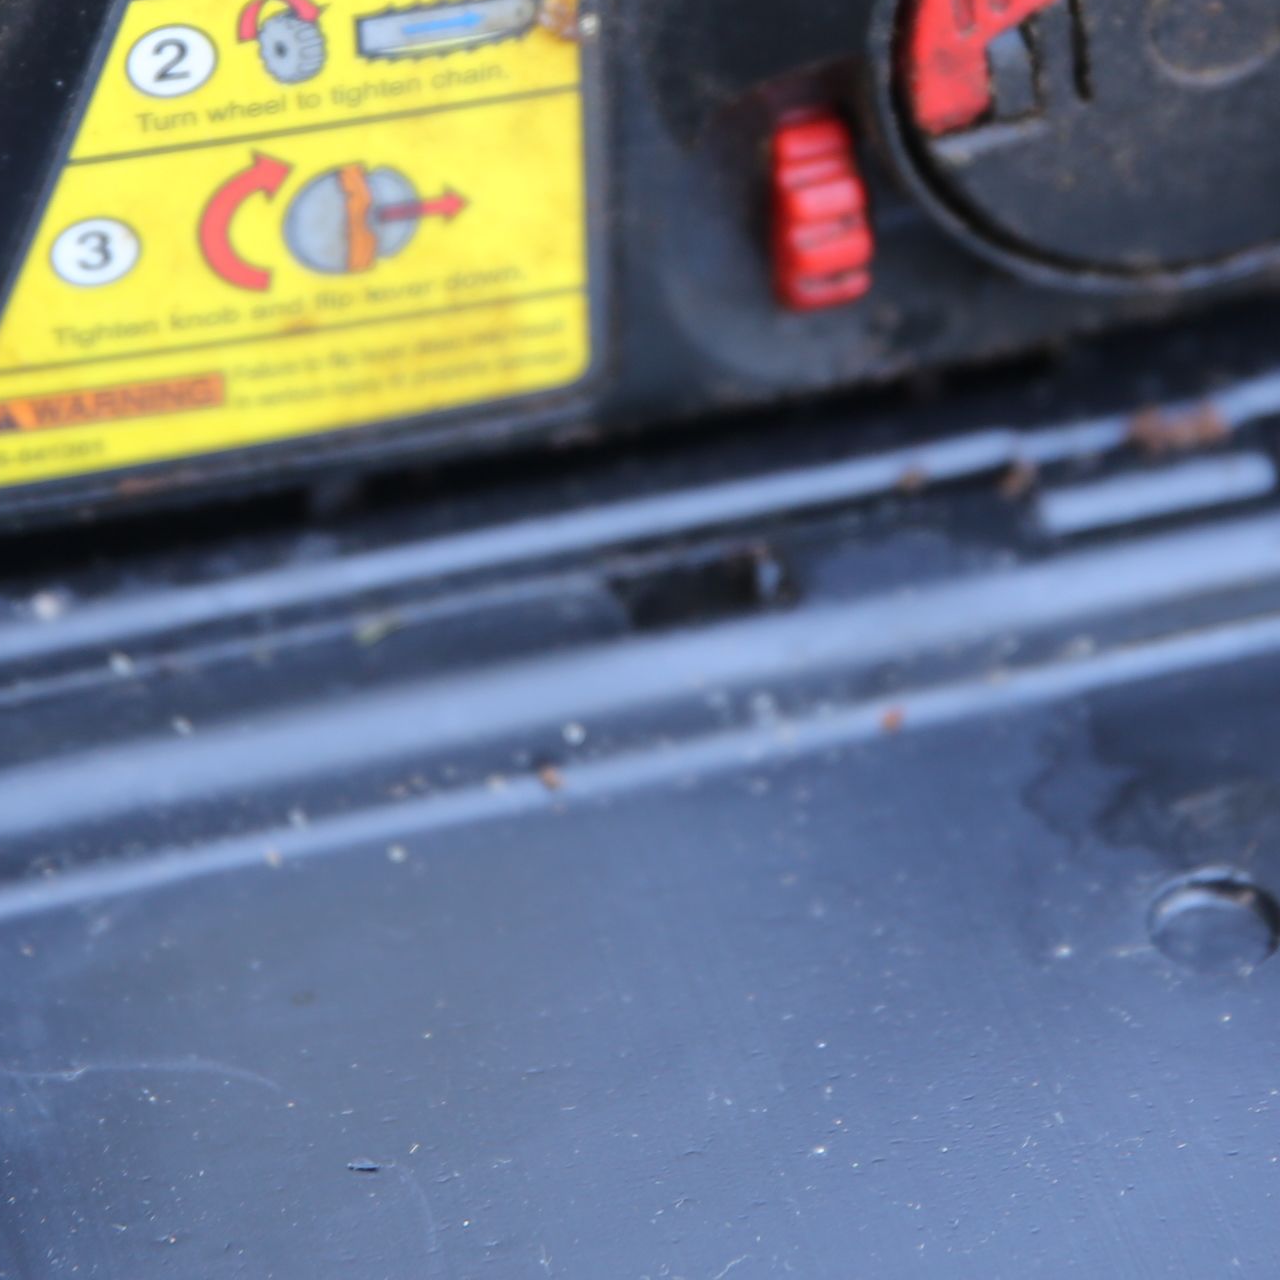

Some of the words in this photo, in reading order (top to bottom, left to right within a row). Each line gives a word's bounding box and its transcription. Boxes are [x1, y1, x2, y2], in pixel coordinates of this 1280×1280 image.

[151, 38, 192, 83] 2
[136, 111, 198, 134] Turn
[206, 95, 286, 124] wheel
[296, 88, 322, 112] to
[330, 75, 422, 108] tighten
[431, 62, 511, 91] chain.
[72, 231, 114, 273] 3
[53, 316, 160, 350] Tighten
[169, 306, 243, 333] knob
[250, 294, 305, 321] and
[314, 287, 356, 315] flip
[34, 377, 218, 429] WARNING
